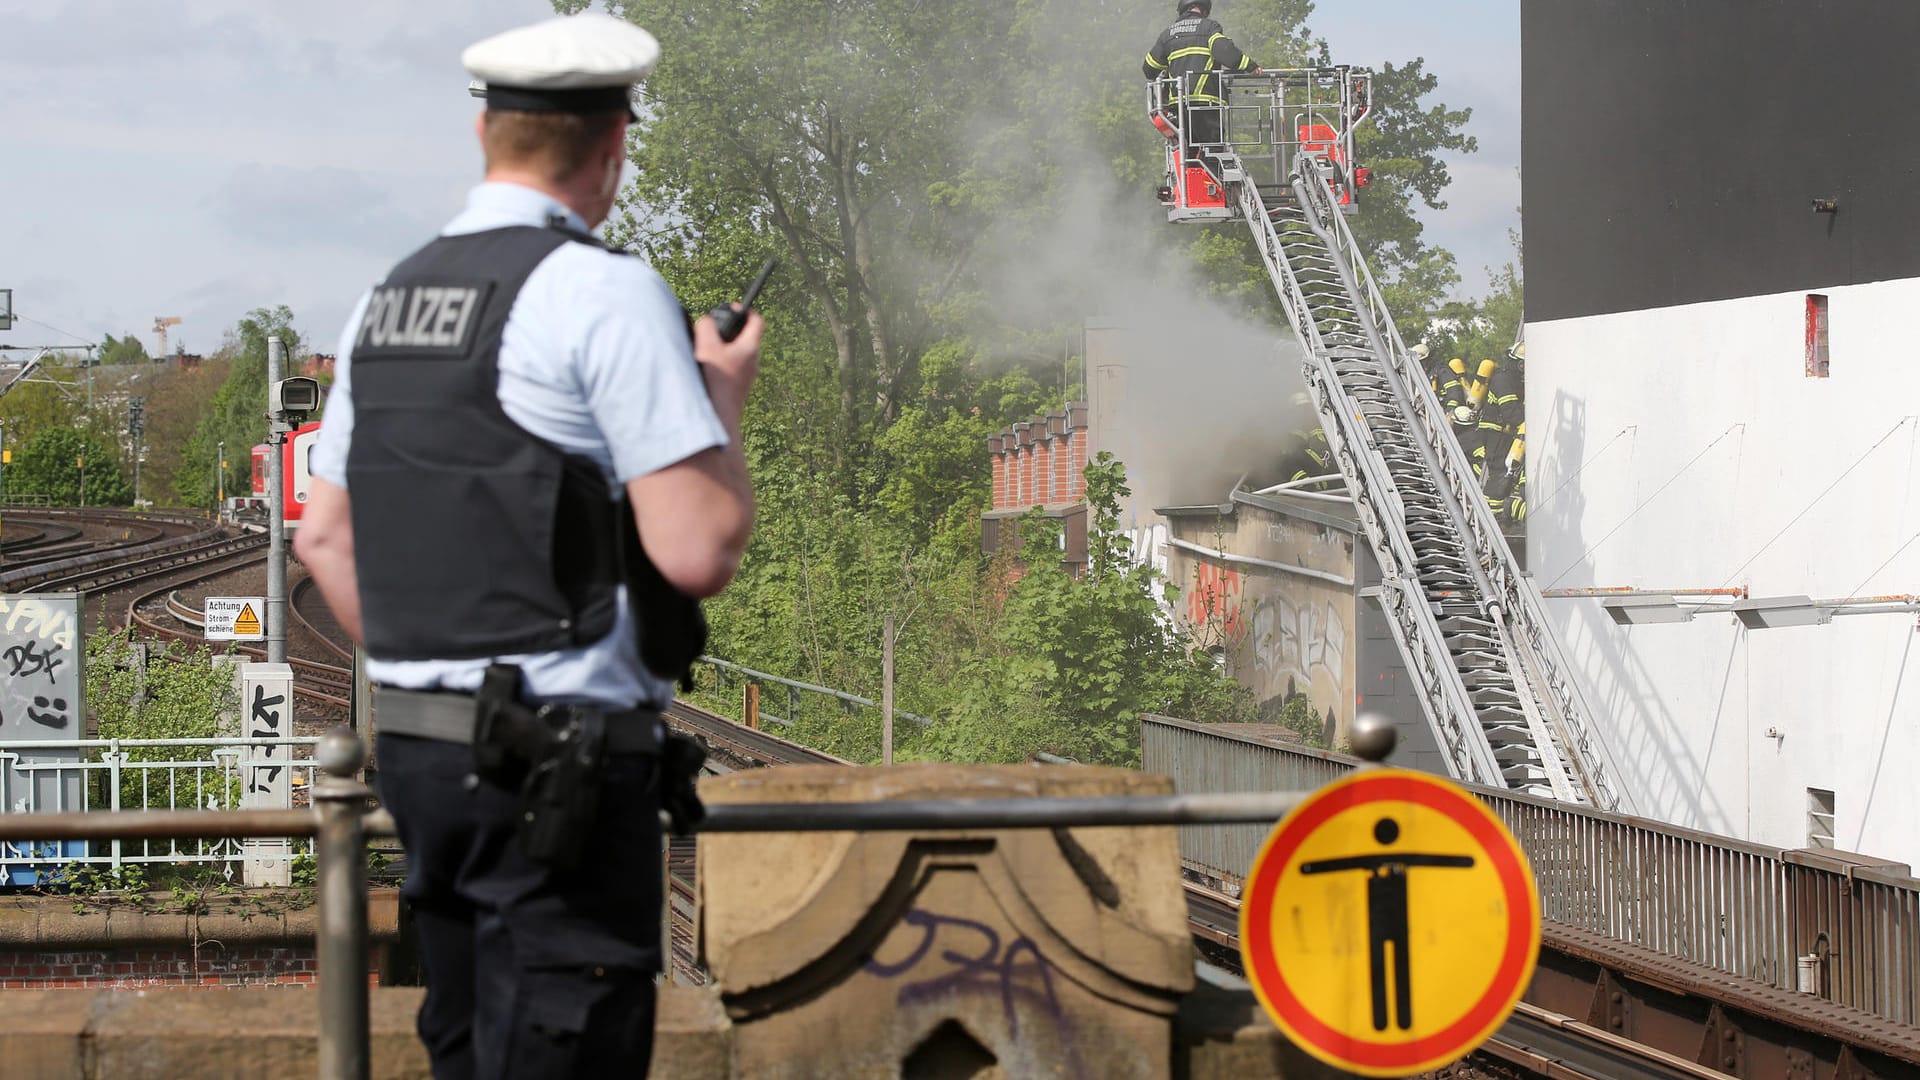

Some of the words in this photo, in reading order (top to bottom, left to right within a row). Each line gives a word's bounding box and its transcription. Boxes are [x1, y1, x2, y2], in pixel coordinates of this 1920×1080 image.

[356, 286, 478, 348] POLIZEI
[208, 601, 240, 612] Achtung
[208, 614, 233, 622] Strom-
